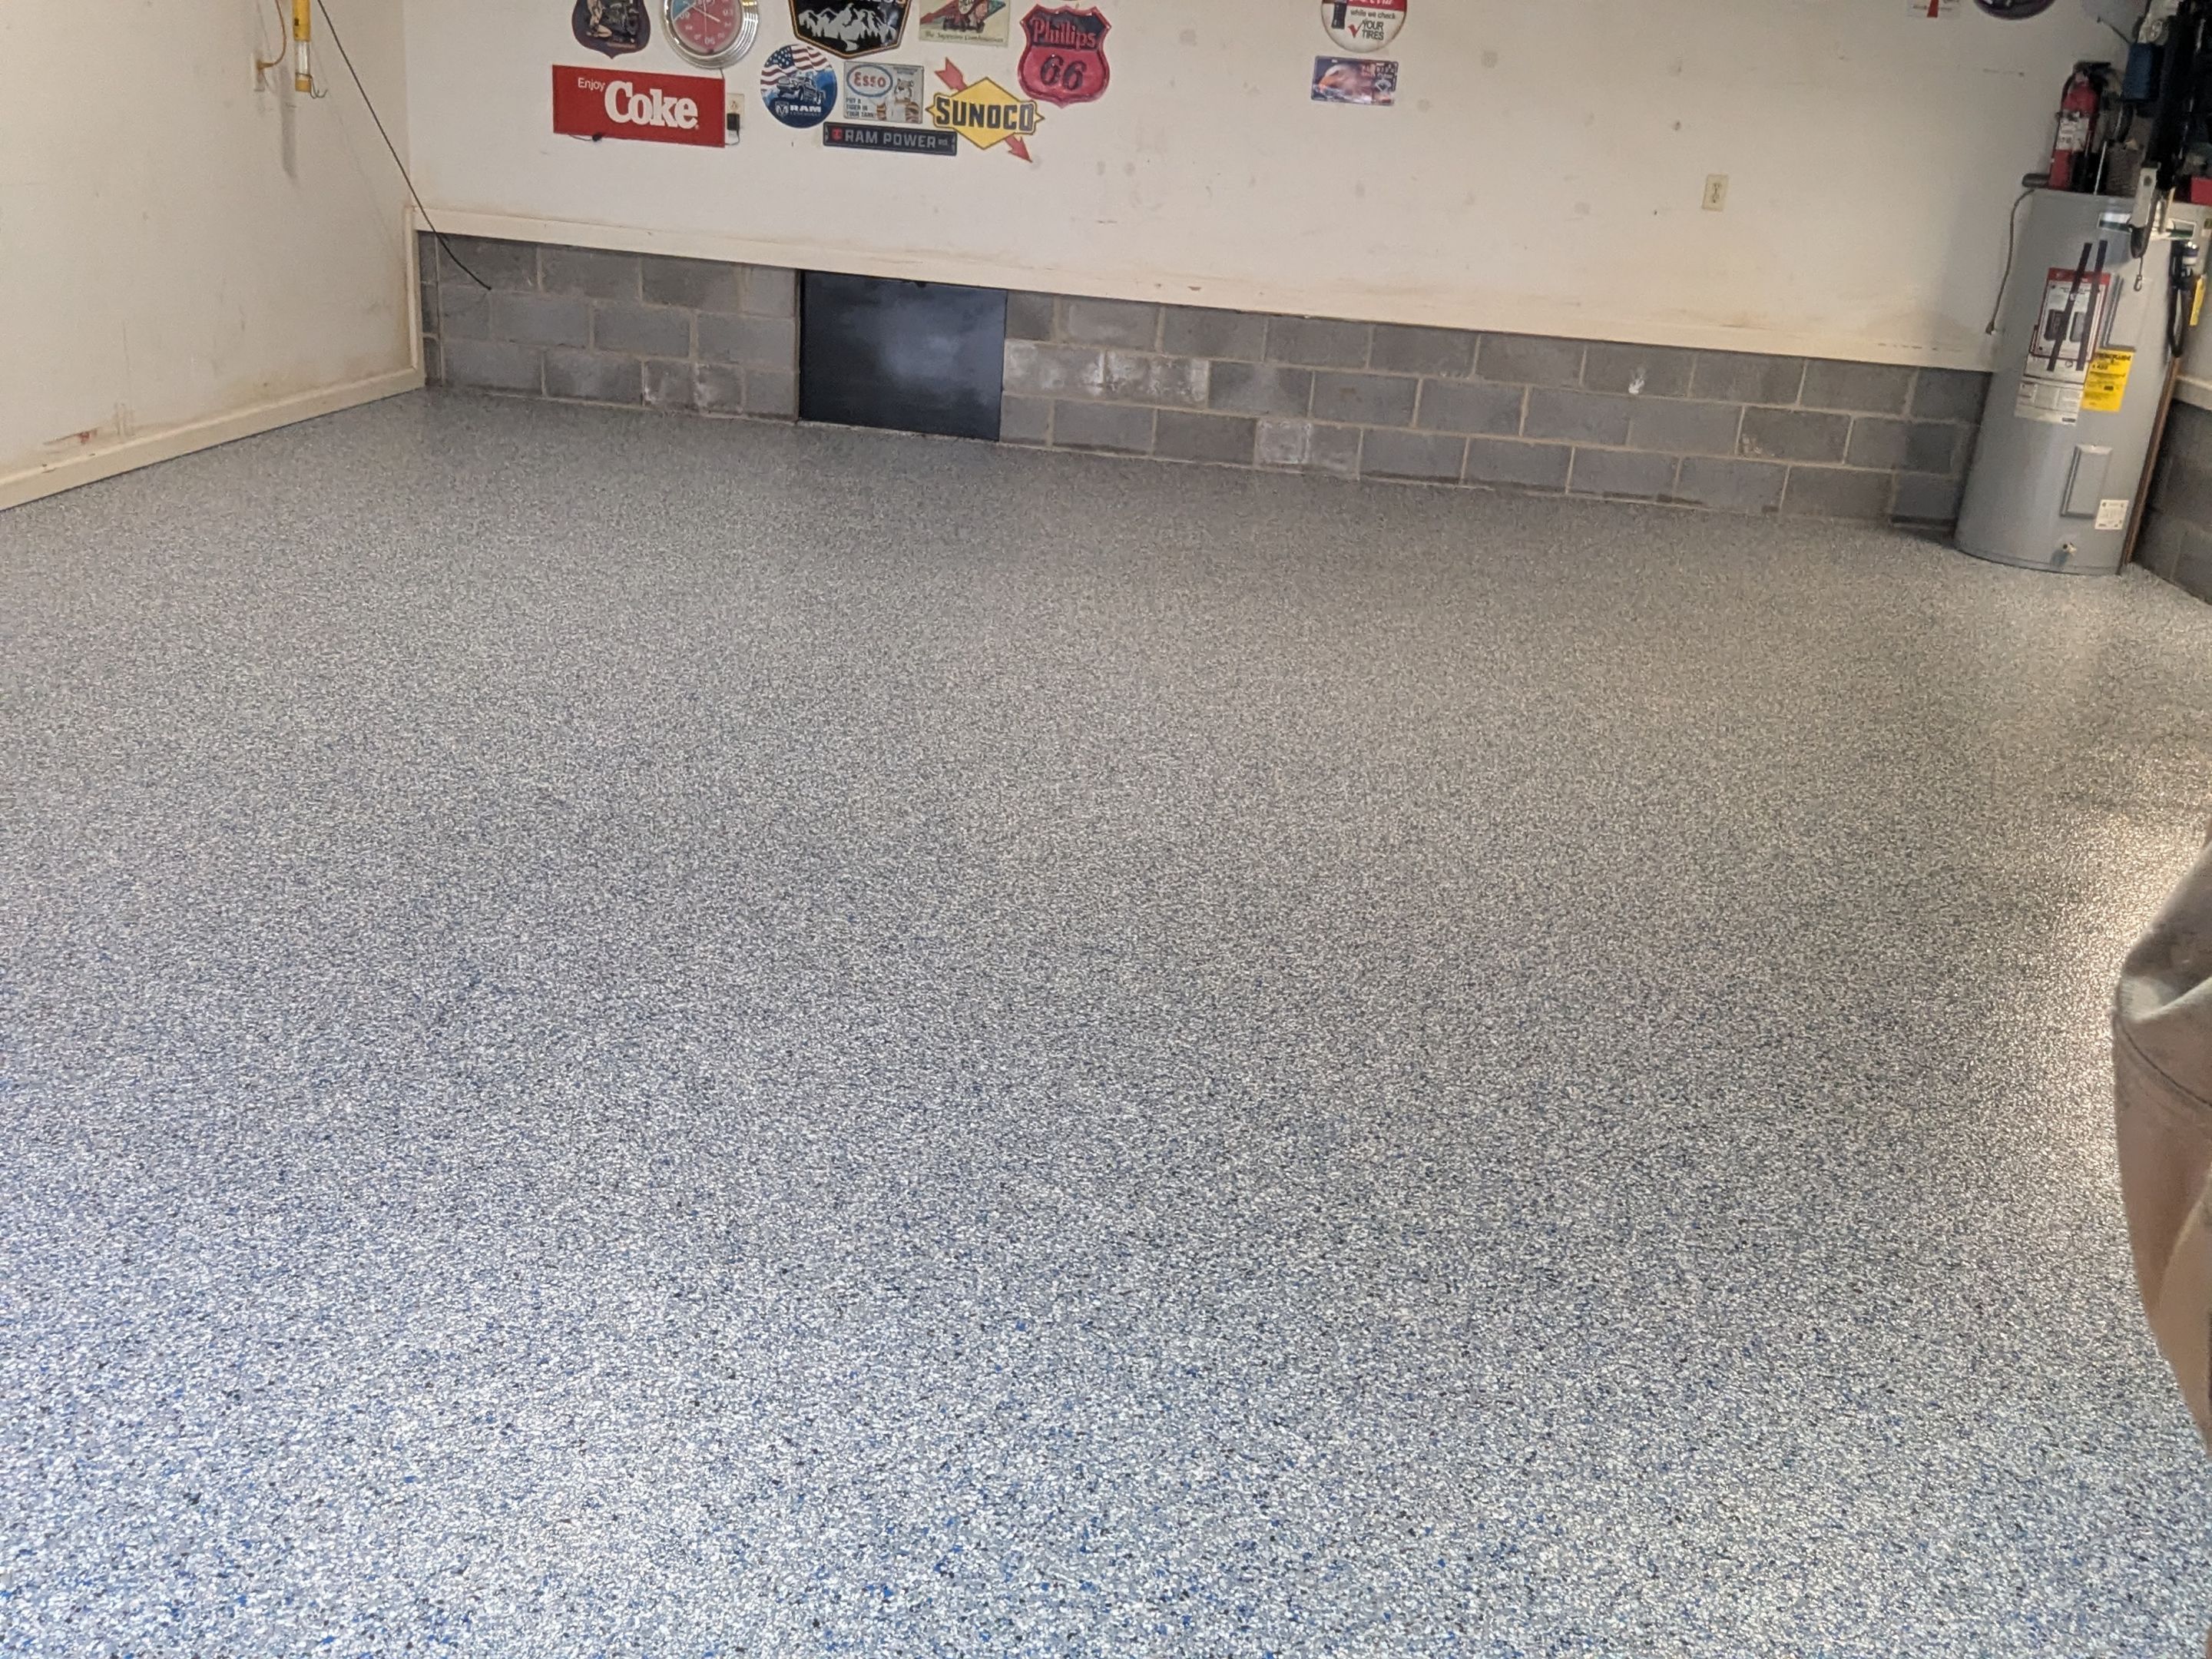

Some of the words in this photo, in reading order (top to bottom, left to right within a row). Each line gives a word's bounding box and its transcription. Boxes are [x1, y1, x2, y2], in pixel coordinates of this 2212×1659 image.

[1029, 17, 1096, 50] Phillips
[1362, 20, 1384, 31] YOUR
[1362, 29, 1384, 41] TIRES
[1040, 55, 1087, 91] 66
[578, 77, 605, 92] Enjoy
[604, 80, 698, 129] Coke
[790, 104, 822, 113] RAM
[936, 97, 1035, 131] SUNOCO
[845, 129, 878, 144] RAM
[883, 131, 936, 148] POWER
